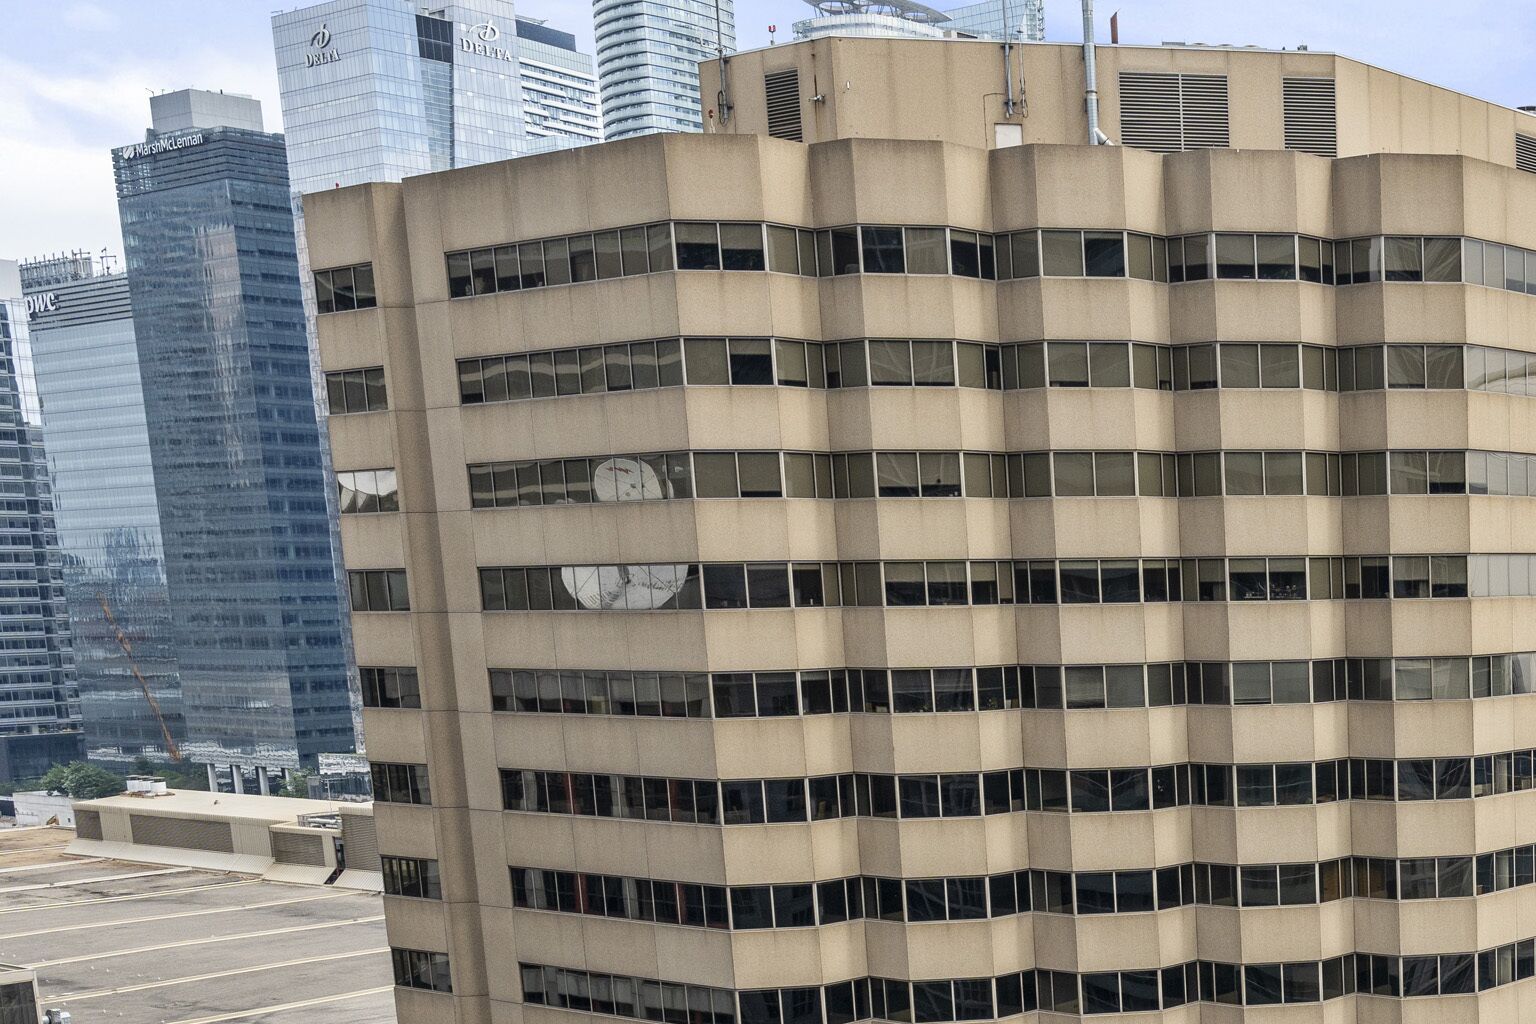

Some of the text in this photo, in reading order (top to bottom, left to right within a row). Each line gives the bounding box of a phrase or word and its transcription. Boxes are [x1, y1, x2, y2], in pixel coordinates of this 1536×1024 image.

[305, 48, 341, 68] DELTA
[460, 38, 512, 62] DELTA
[24, 292, 56, 321] pwc
